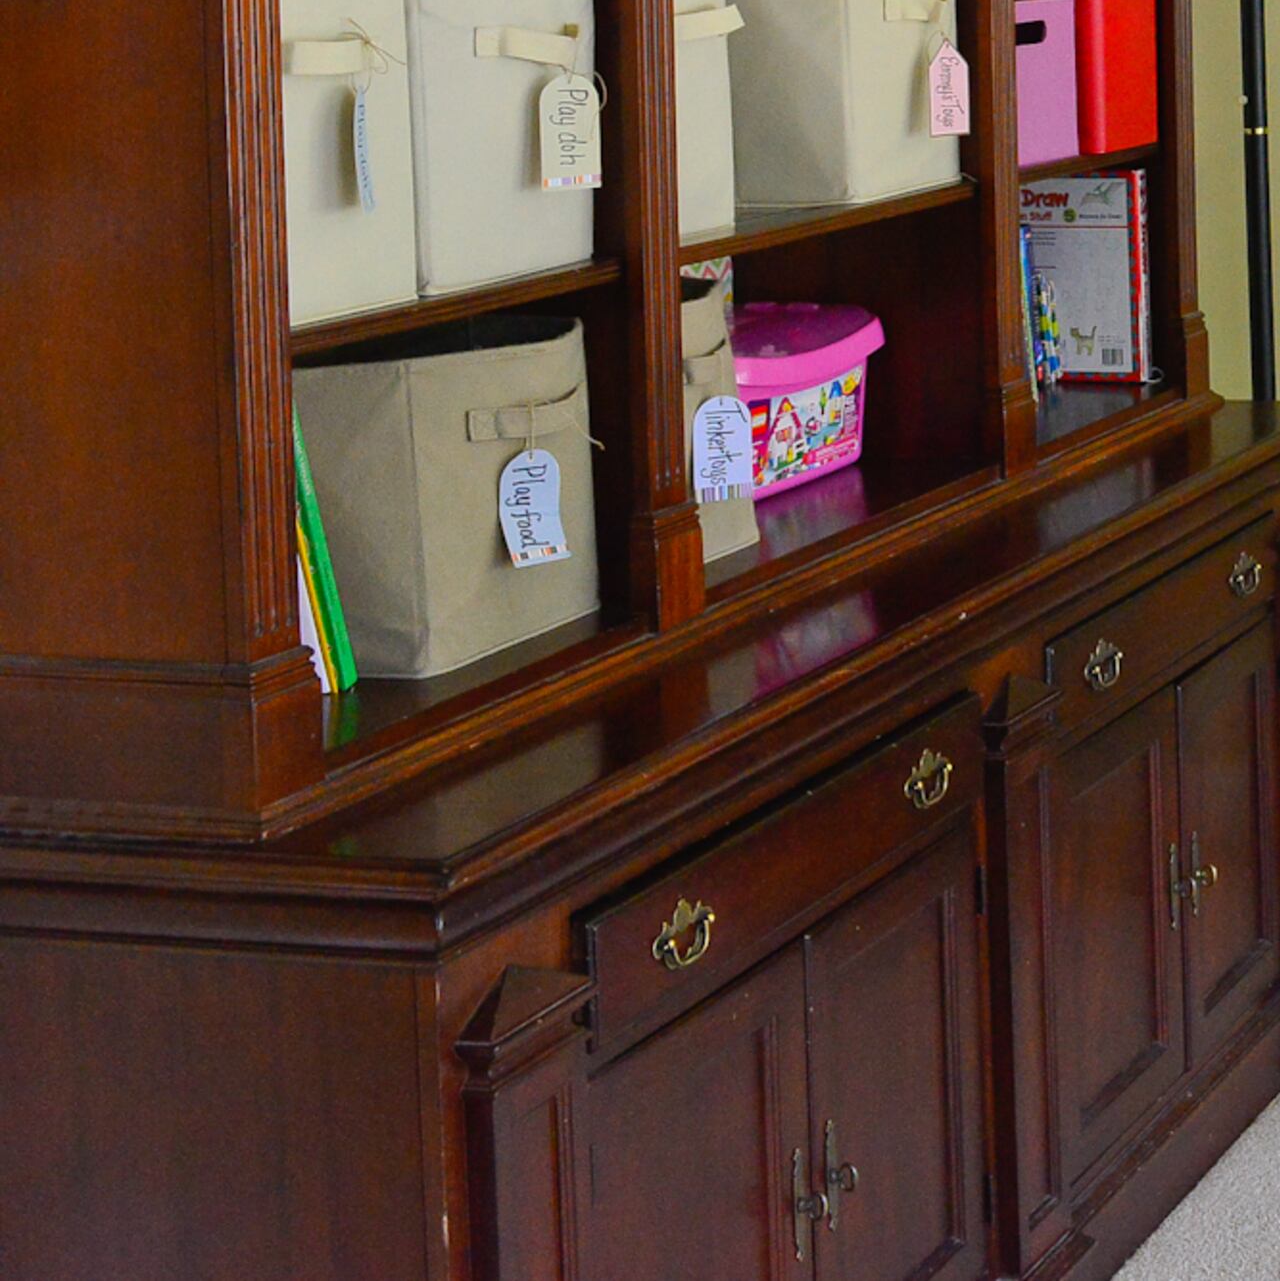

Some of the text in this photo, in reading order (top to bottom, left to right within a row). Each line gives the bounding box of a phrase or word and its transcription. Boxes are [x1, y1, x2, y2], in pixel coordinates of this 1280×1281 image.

[548, 89, 589, 166] Play doh
[935, 99, 965, 128] Toys
[1021, 189, 1069, 207] Draw
[700, 401, 747, 486] Tinkertoys
[504, 464, 550, 549] Play food
